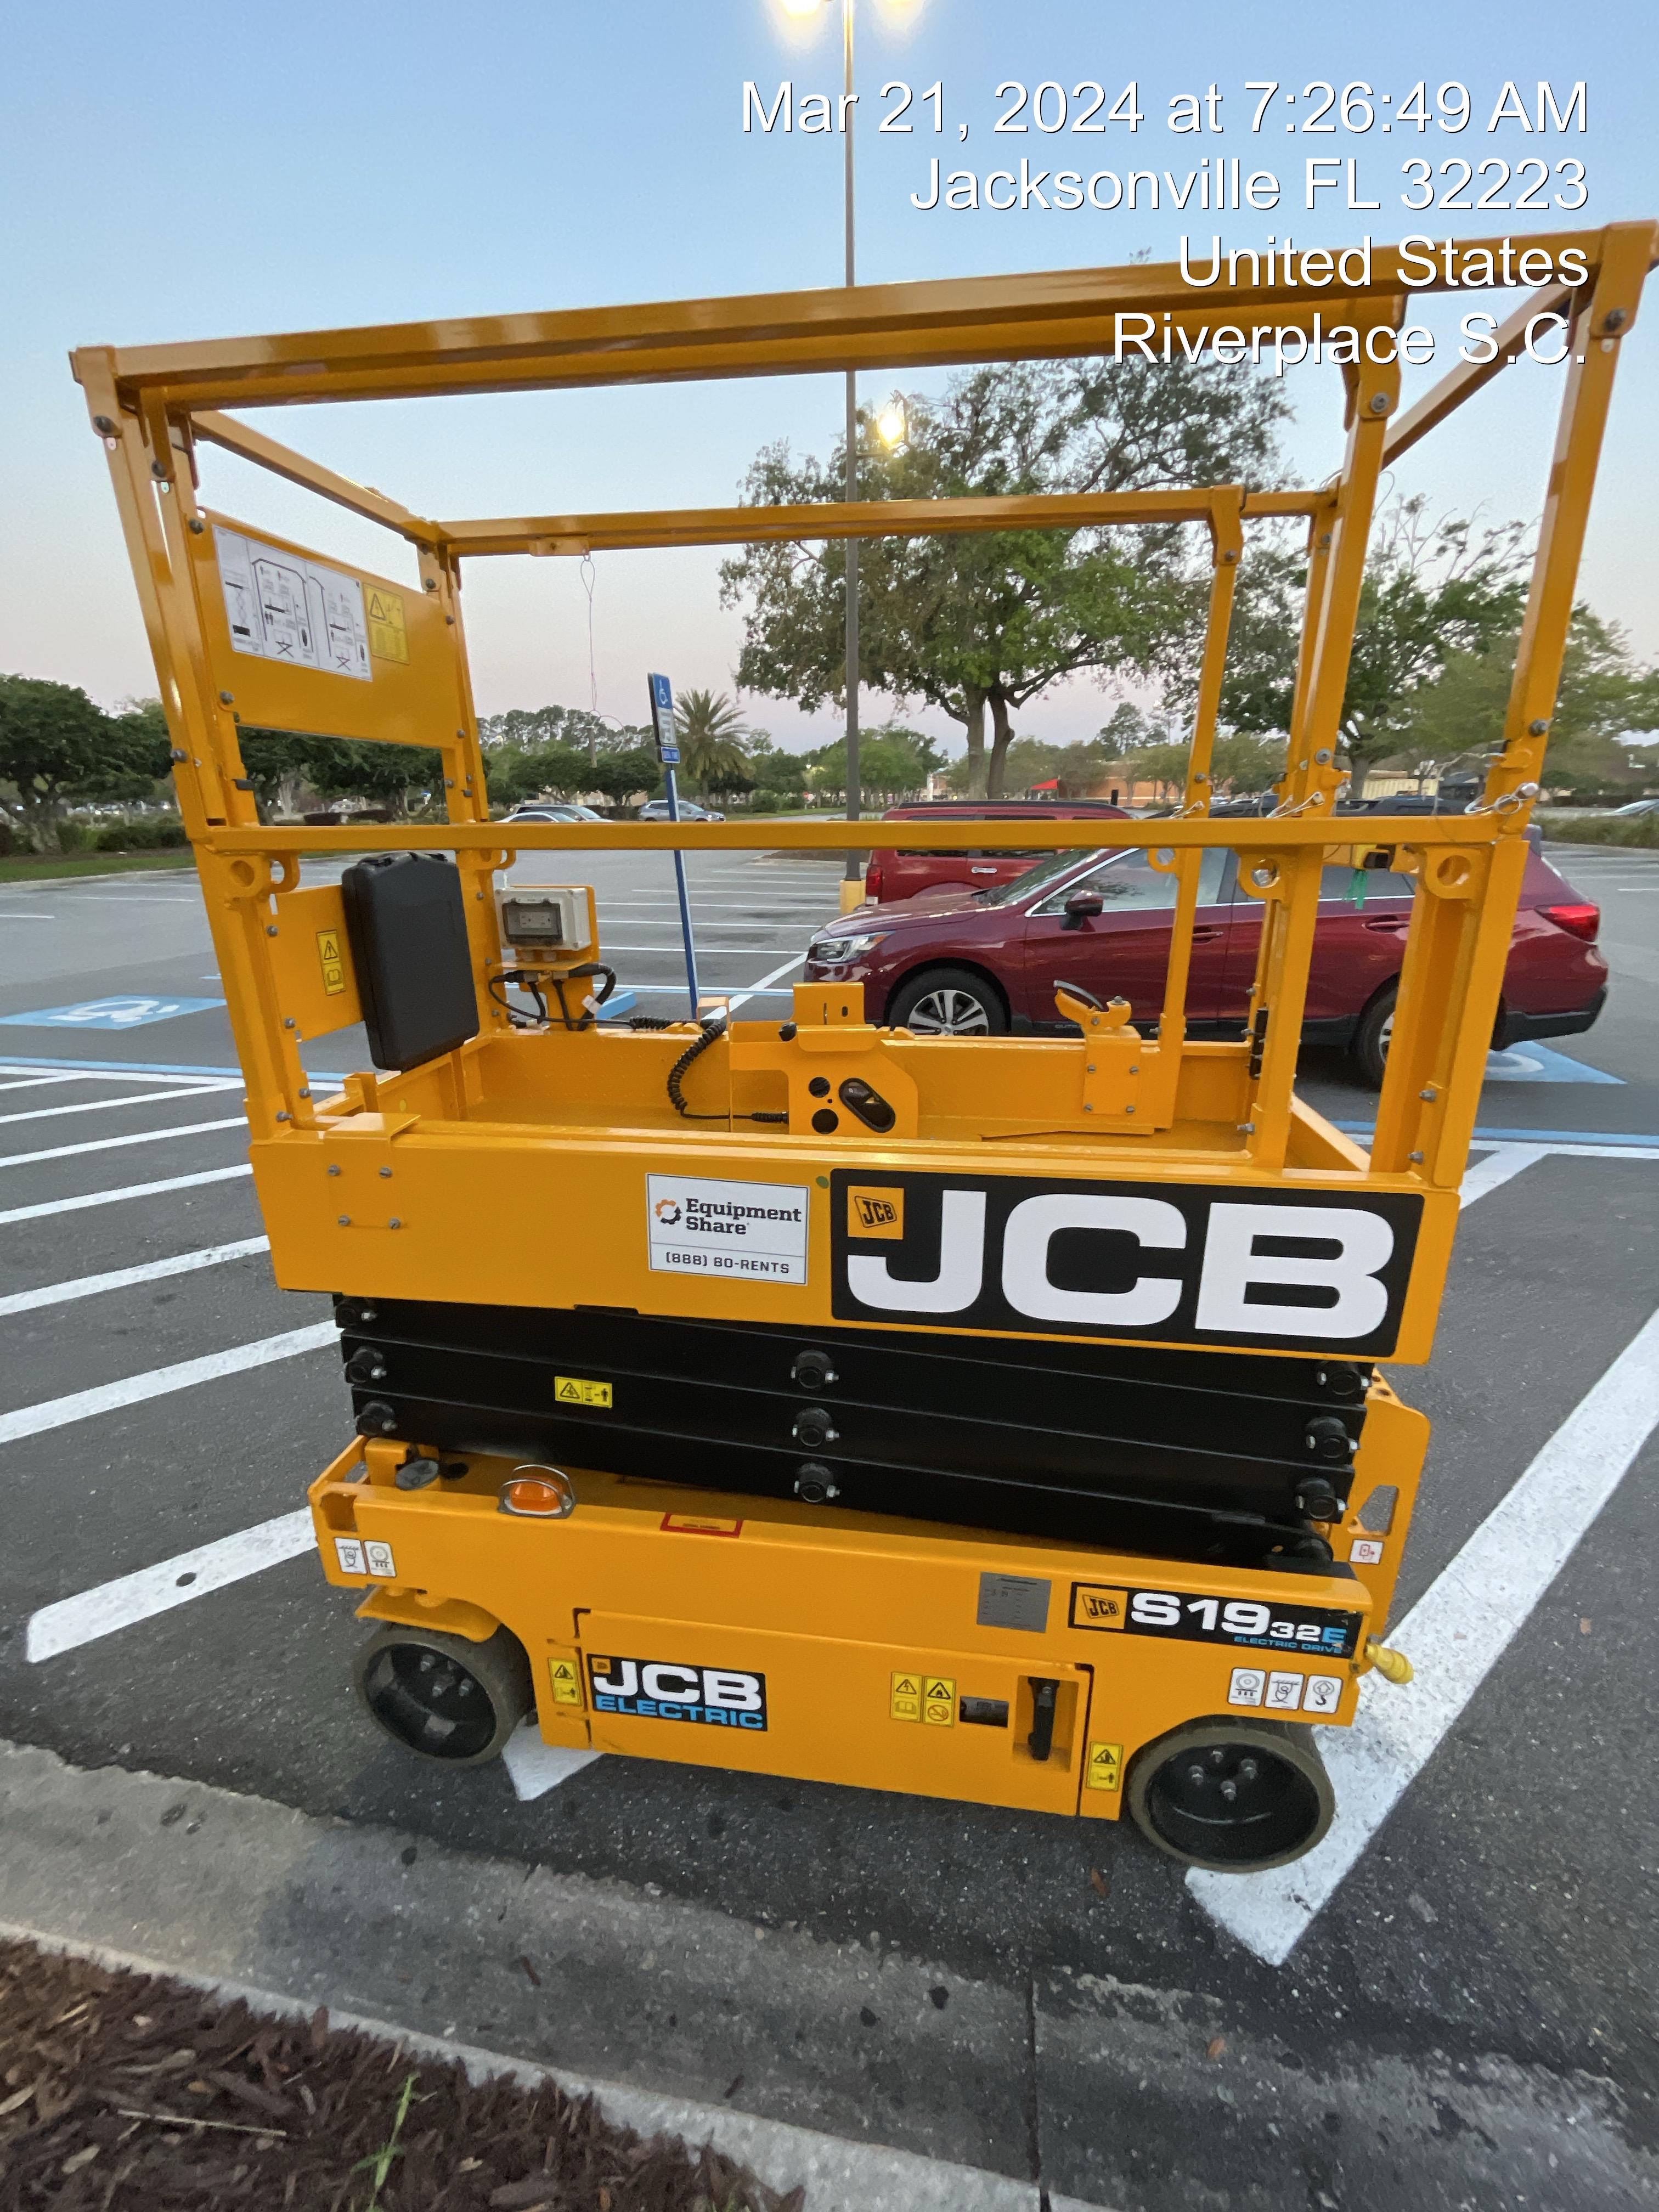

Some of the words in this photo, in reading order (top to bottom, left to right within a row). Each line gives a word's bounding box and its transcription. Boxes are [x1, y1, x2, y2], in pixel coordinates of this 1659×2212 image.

[686, 1198, 802, 1222] Equipment
[862, 1200, 894, 1224] JCB
[686, 1216, 747, 1235] Share
[665, 1251, 708, 1267] (888)
[713, 1257, 790, 1274] 80-RENTS
[848, 1190, 1395, 1339] JCB
[1089, 1598, 1117, 1617] JCB
[1234, 1636, 1297, 1649] ELECTRIC
[594, 1660, 762, 1711] JCB
[595, 1694, 763, 1729] ELECTRIC
